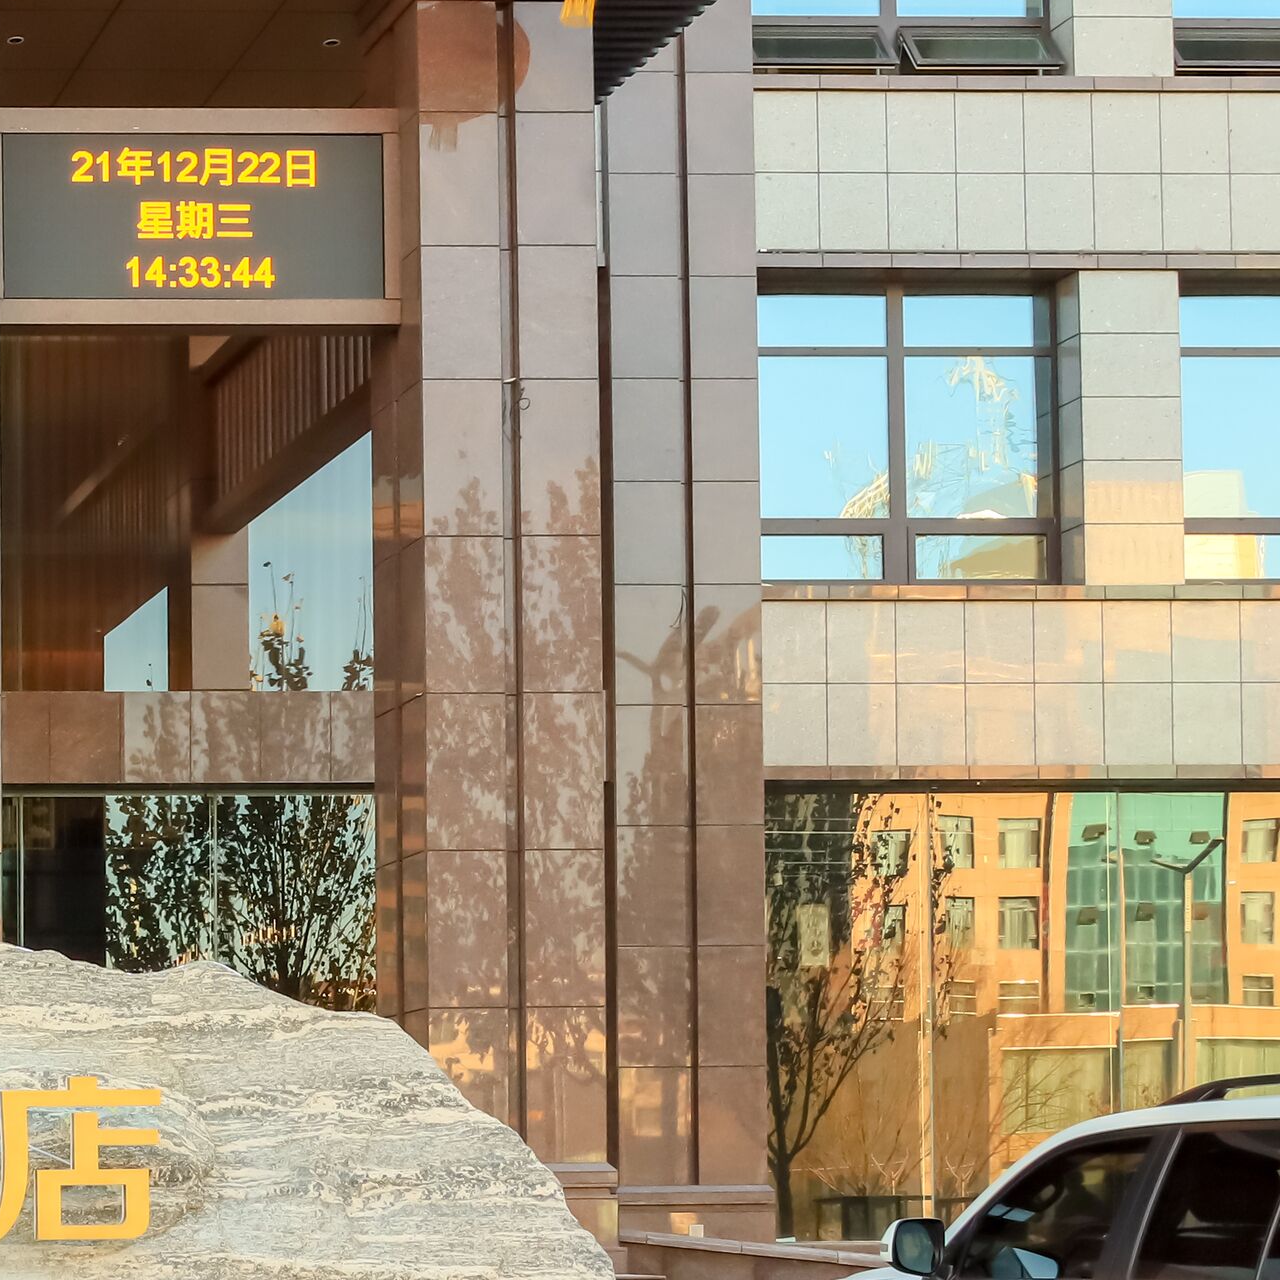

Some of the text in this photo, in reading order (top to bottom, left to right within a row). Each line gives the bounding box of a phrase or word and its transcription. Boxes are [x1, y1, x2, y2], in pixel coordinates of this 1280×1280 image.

[70, 146, 317, 188] 21年12月22日
[136, 199, 255, 242] 星期三
[125, 256, 276, 289] 14:33:44
